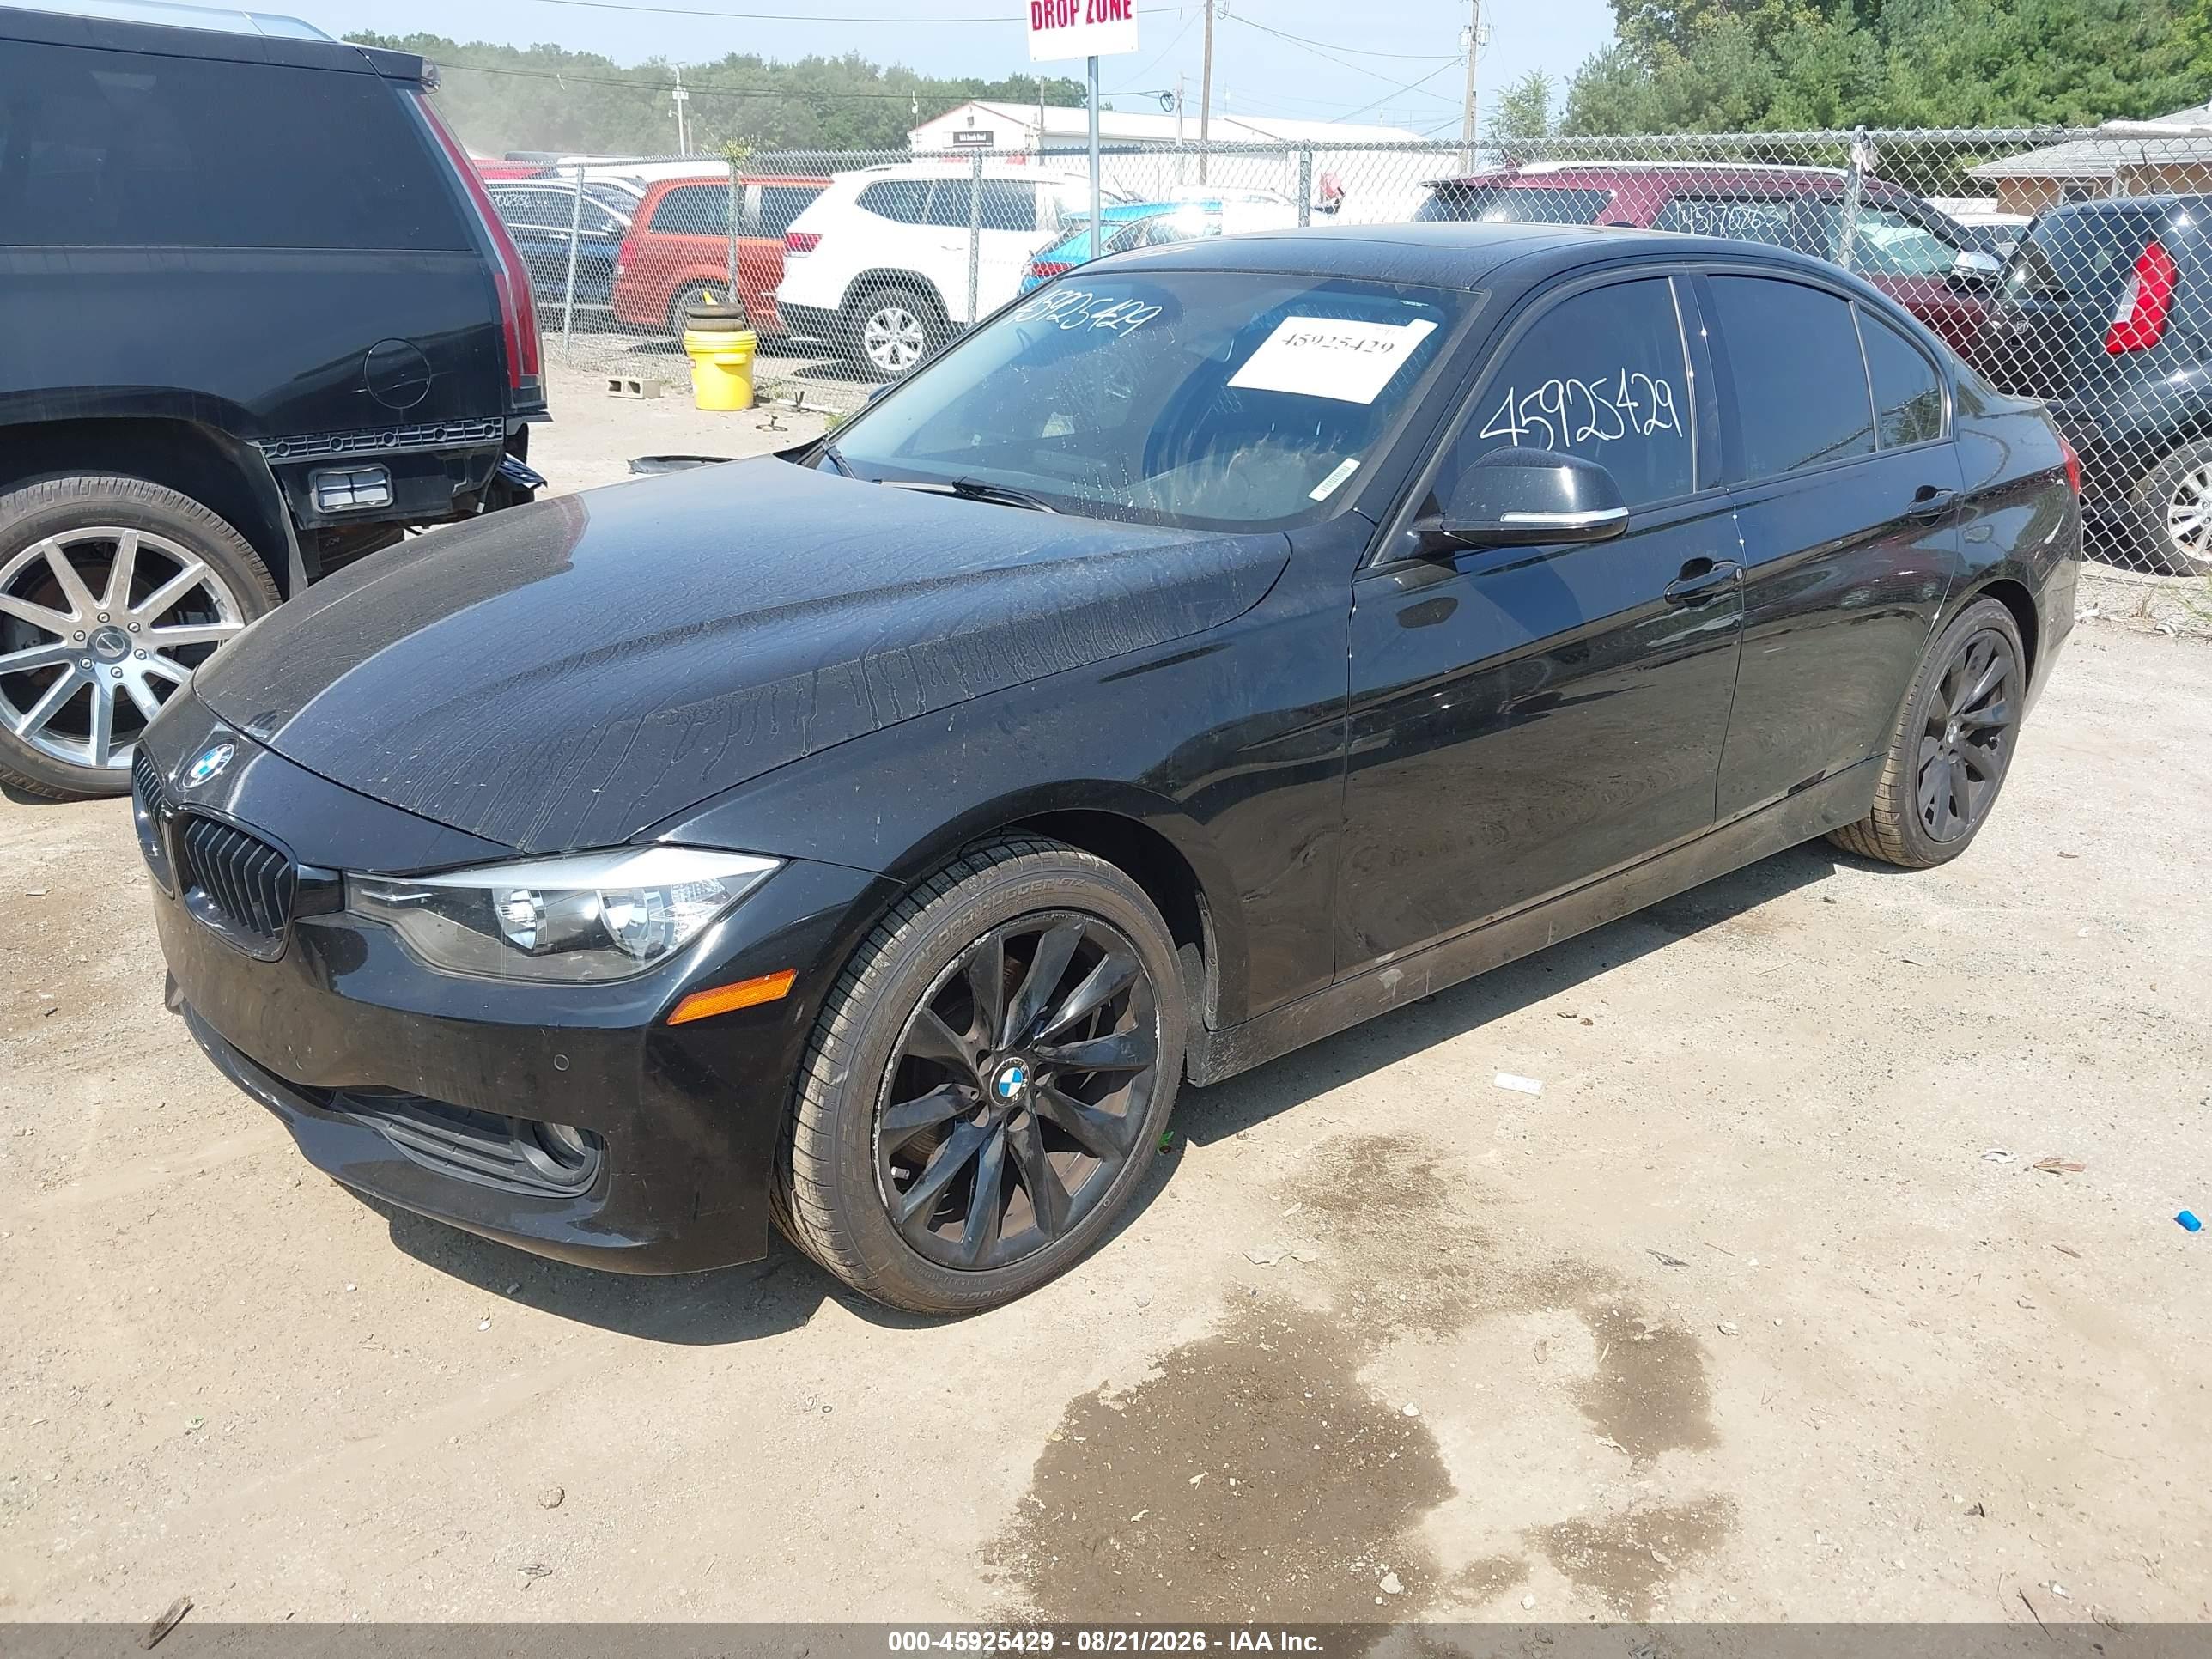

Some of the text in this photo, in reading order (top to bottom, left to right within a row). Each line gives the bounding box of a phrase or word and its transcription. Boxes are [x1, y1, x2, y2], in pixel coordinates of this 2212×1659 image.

[1031, 0, 1133, 31] DROP ZONE
[1480, 367, 1683, 451] 45925429
